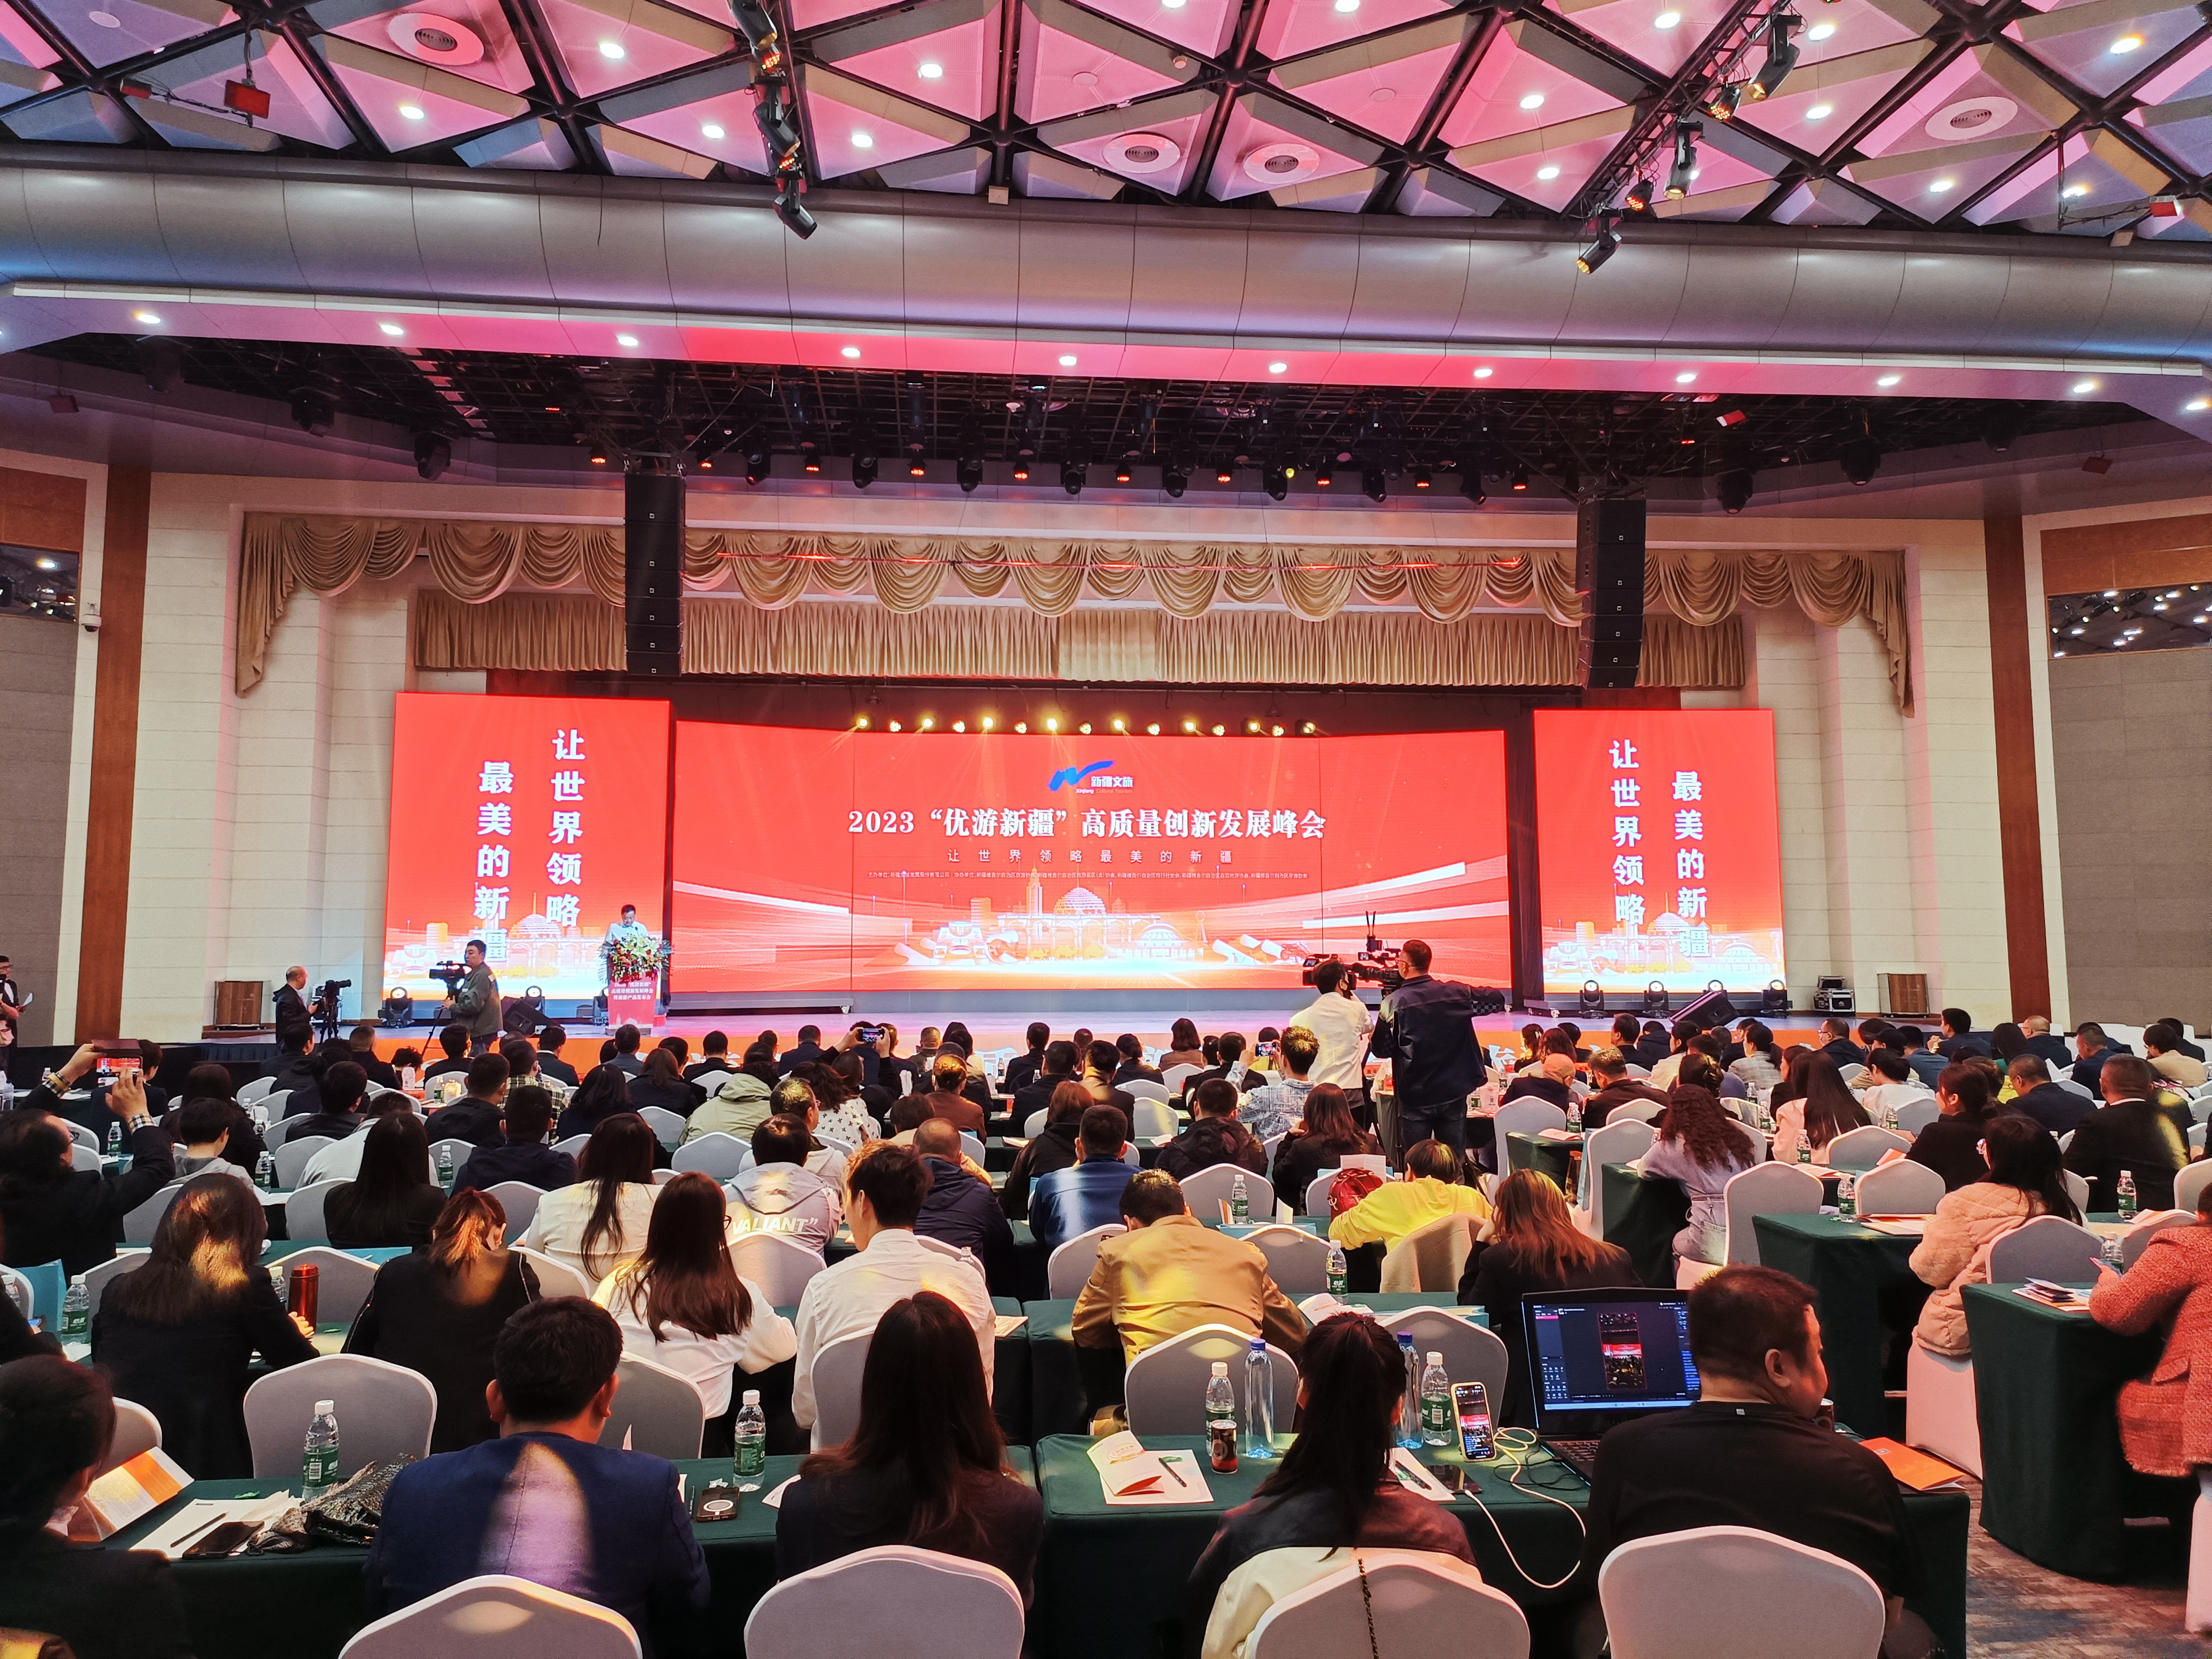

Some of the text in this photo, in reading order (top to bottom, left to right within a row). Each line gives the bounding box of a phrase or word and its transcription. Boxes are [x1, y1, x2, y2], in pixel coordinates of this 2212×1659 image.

[474, 760, 514, 962] 最美的新疆
[546, 729, 585, 927] 让世界领略
[1091, 775, 1134, 787] 新疆文旅
[1609, 739, 1645, 925] 让世界领略
[1671, 771, 1710, 957] 最美的新疆
